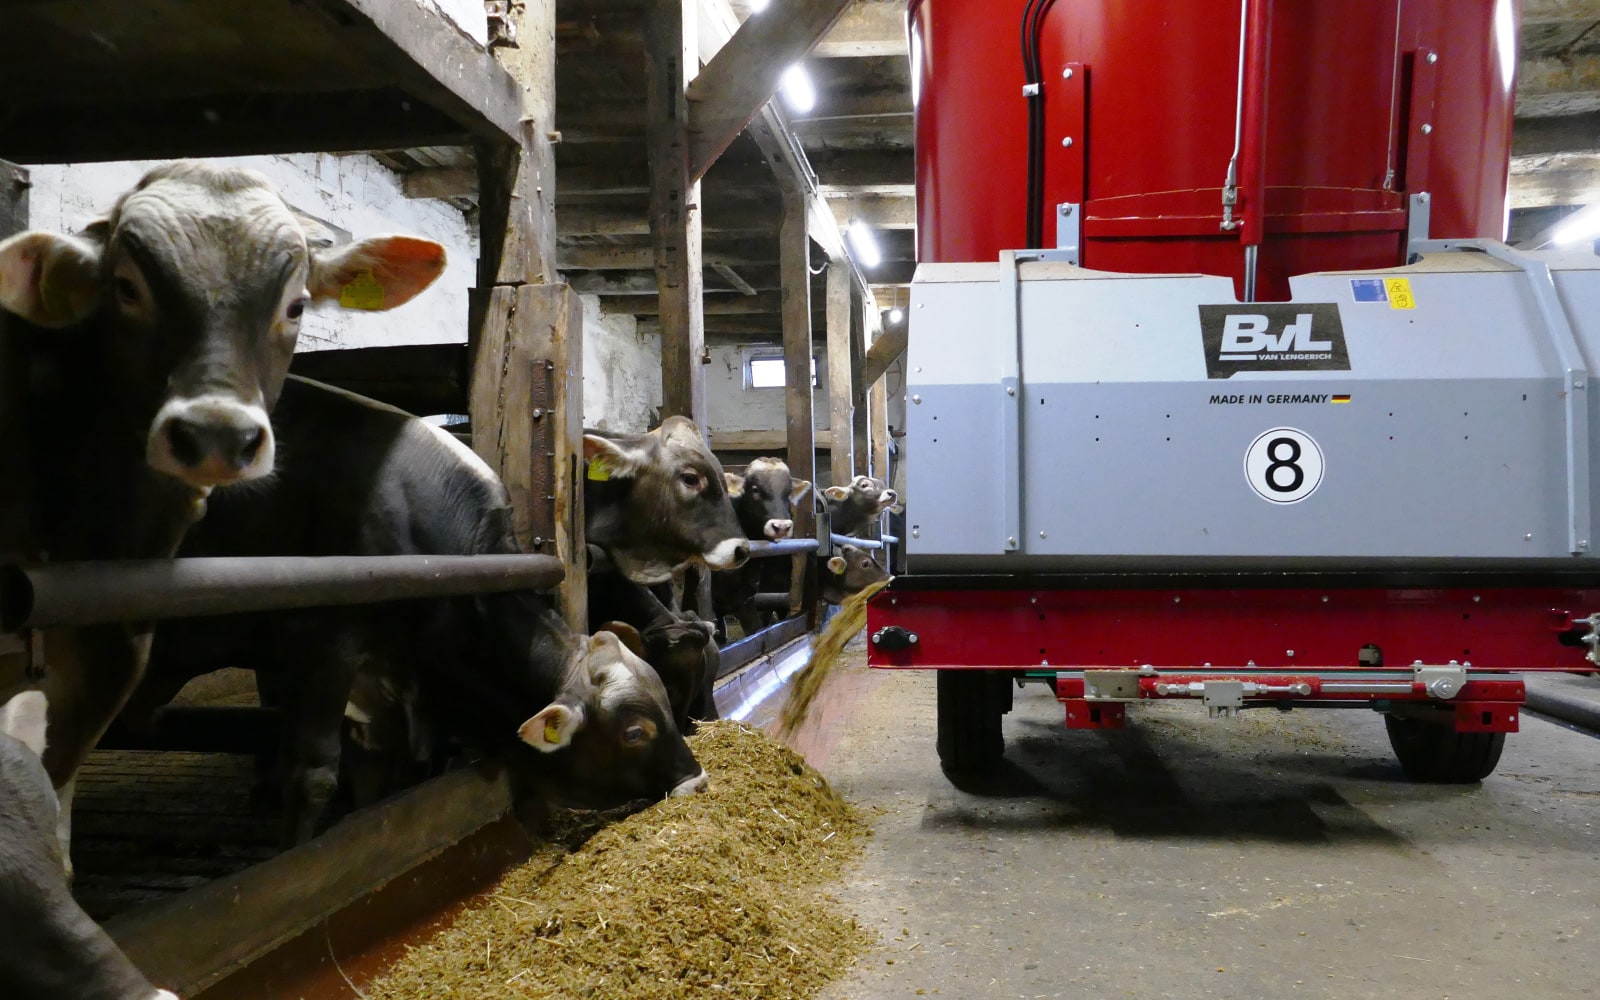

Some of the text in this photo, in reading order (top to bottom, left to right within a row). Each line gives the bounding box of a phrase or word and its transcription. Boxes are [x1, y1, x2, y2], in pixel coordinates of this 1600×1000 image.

[1220, 313, 1332, 352] BvL
[1209, 394, 1328, 404] MADE IN GERMANY
[1265, 437, 1304, 493] 8
